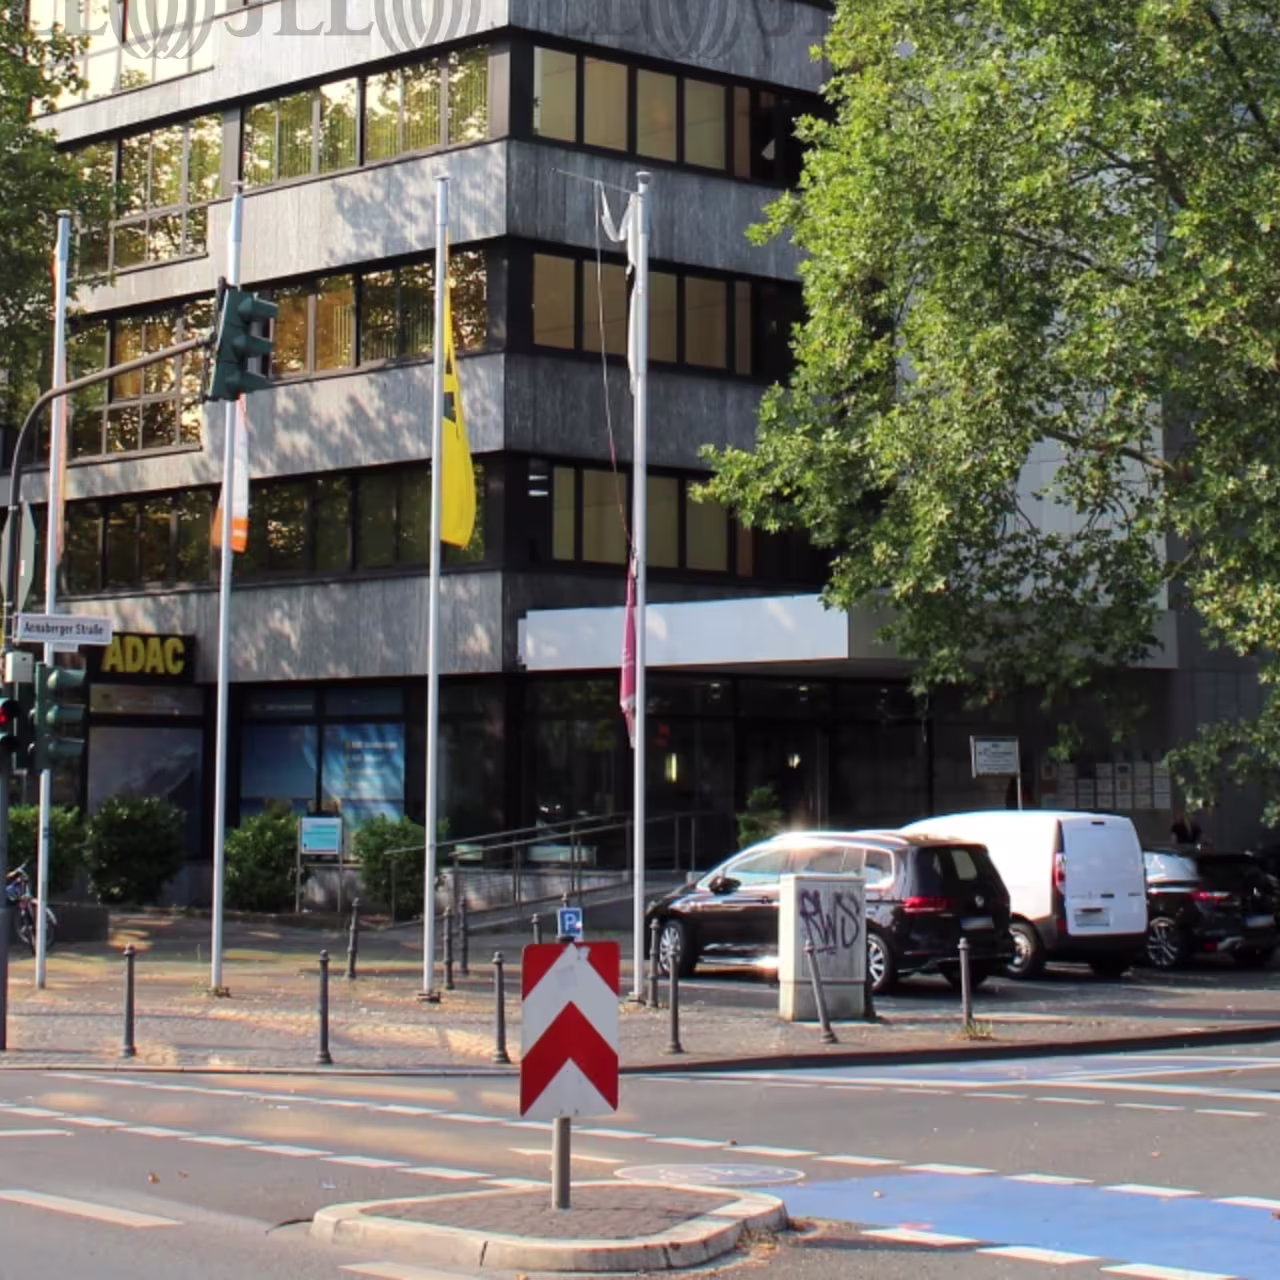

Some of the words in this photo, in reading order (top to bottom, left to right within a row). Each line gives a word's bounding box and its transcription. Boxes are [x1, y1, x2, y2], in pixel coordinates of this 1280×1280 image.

[24, 622, 74, 636] Annaberger
[76, 624, 104, 635] Straße
[101, 635, 184, 675] ADAC
[564, 913, 577, 931] P
